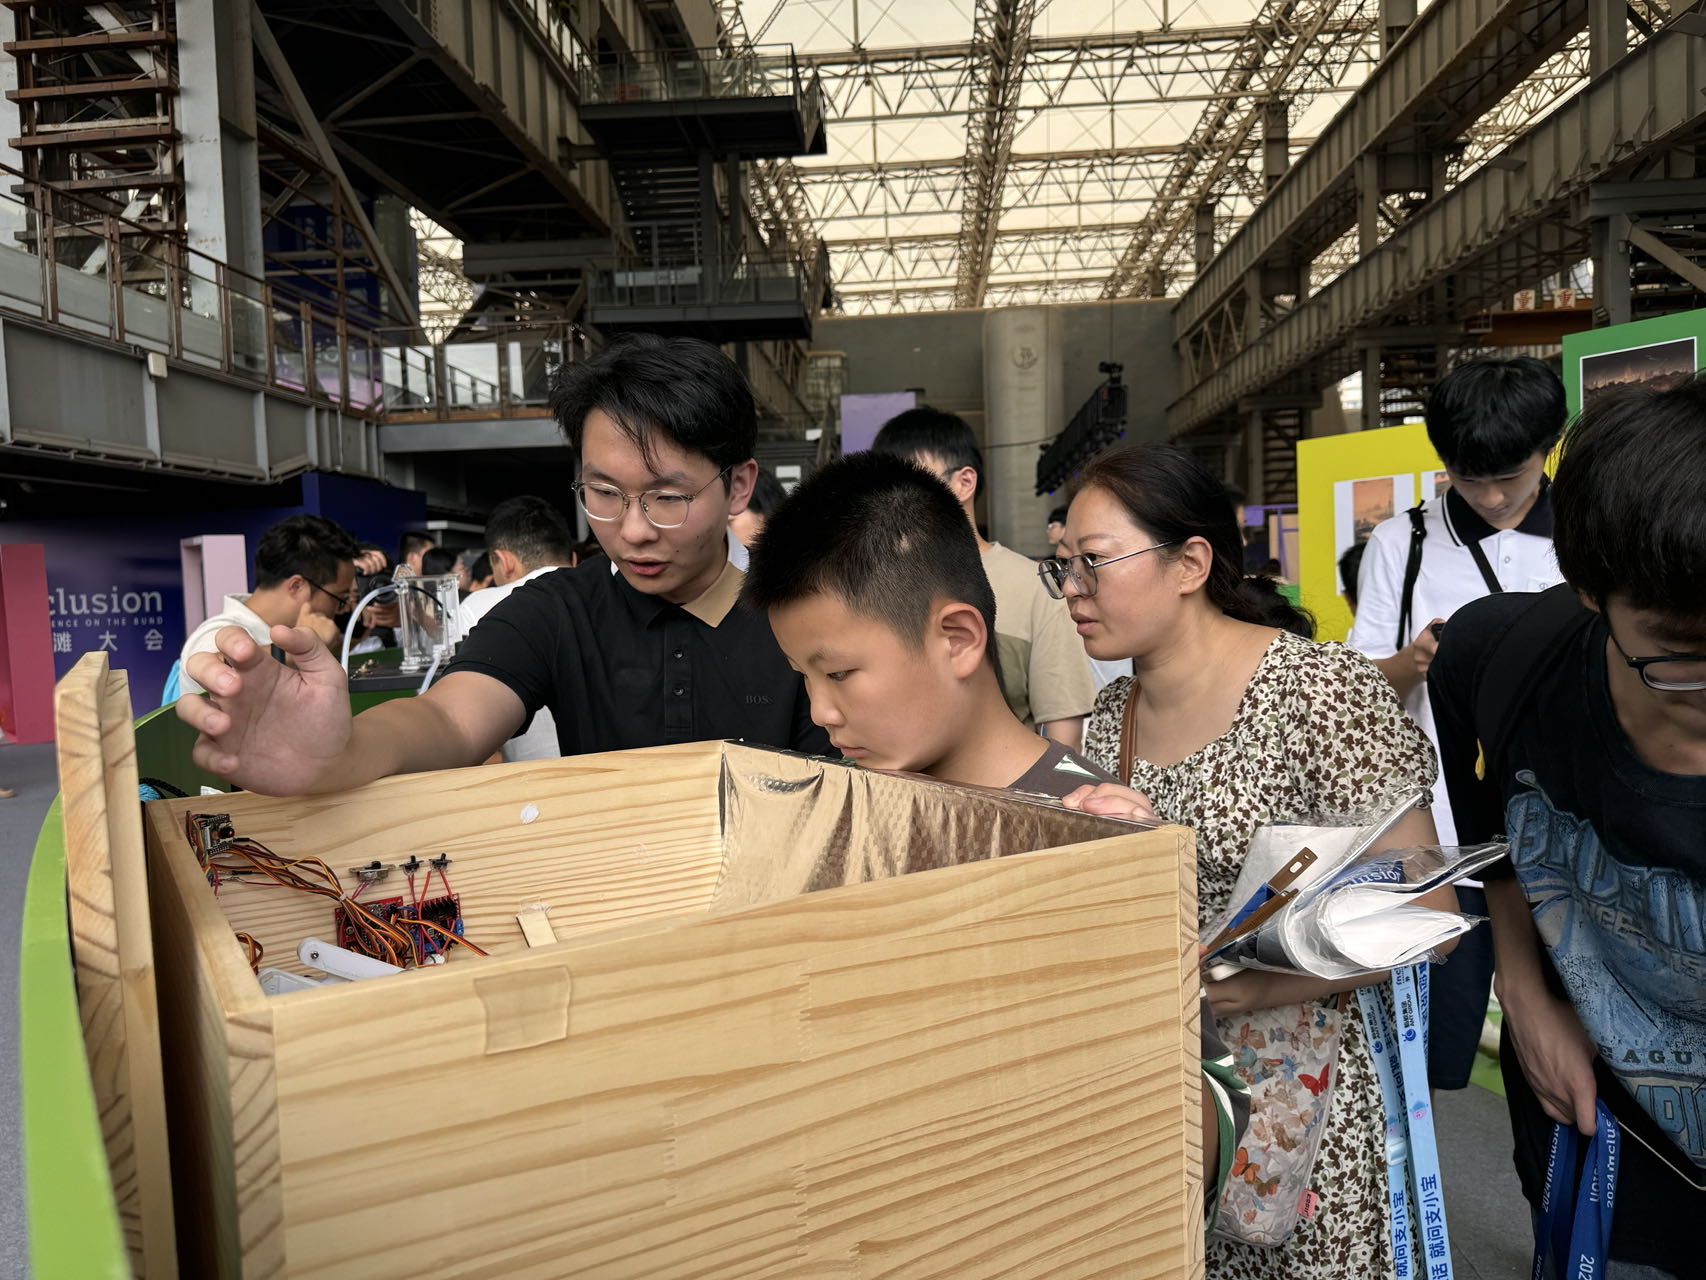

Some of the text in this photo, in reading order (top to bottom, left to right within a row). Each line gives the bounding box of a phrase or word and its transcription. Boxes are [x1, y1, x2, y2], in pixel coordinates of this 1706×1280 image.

[85, 618, 100, 627] ON
[107, 617, 126, 627] THE
[134, 615, 163, 626] BUND
[1420, 1174, 1446, 1259] 就问支小宝
[1606, 1174, 1615, 1208] 2024
[1393, 1190, 1408, 1277] 就问支小宝
